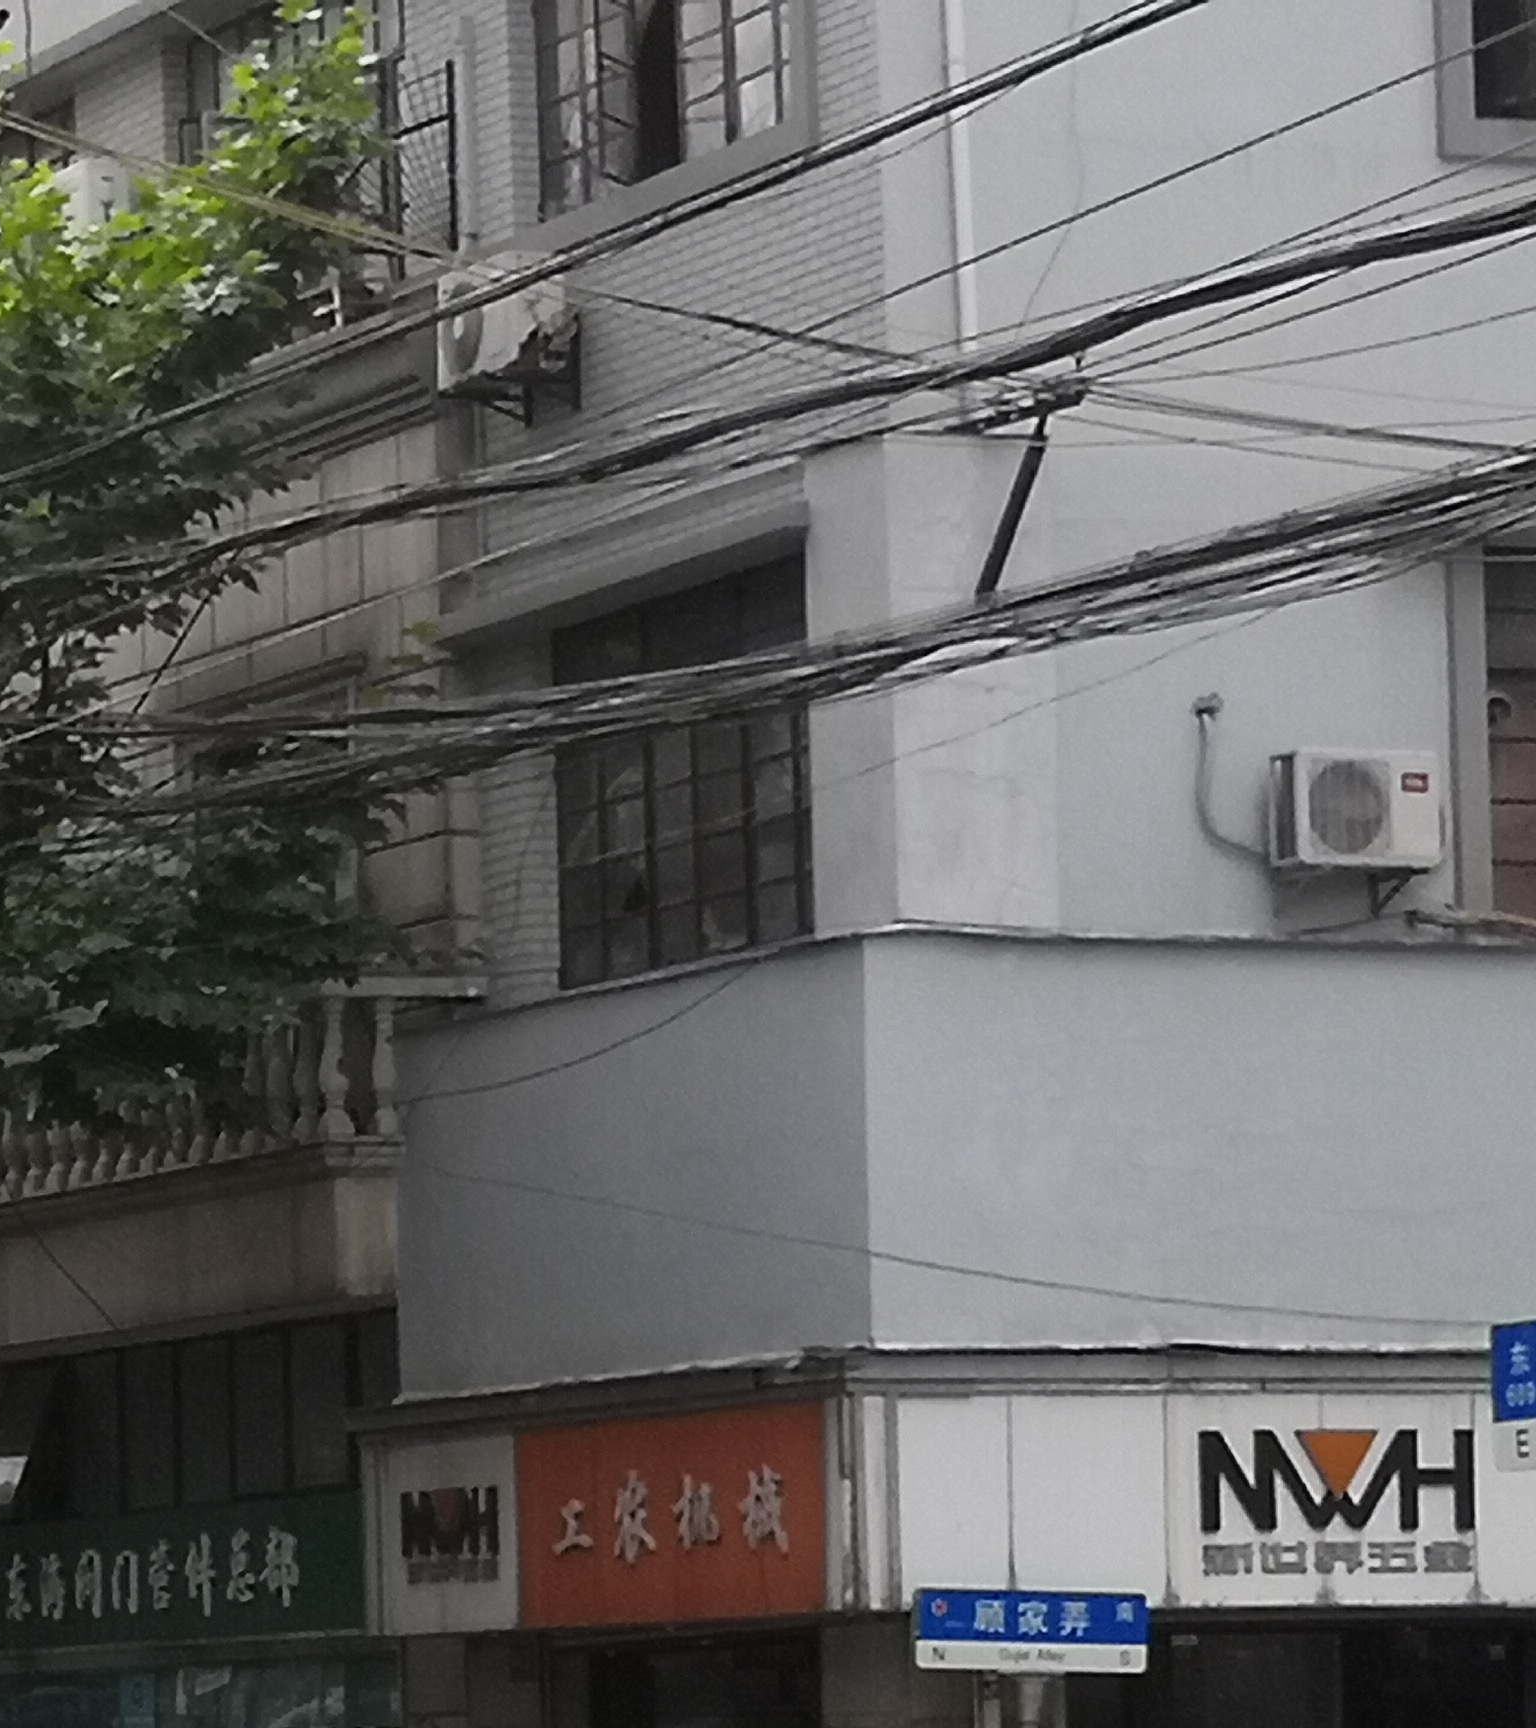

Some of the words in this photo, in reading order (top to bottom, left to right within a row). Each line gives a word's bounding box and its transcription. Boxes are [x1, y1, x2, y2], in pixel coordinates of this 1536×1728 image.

[1516, 1428, 1529, 1459] E
[973, 1599, 1092, 1637] 顾家弄
[932, 1647, 946, 1661] N
